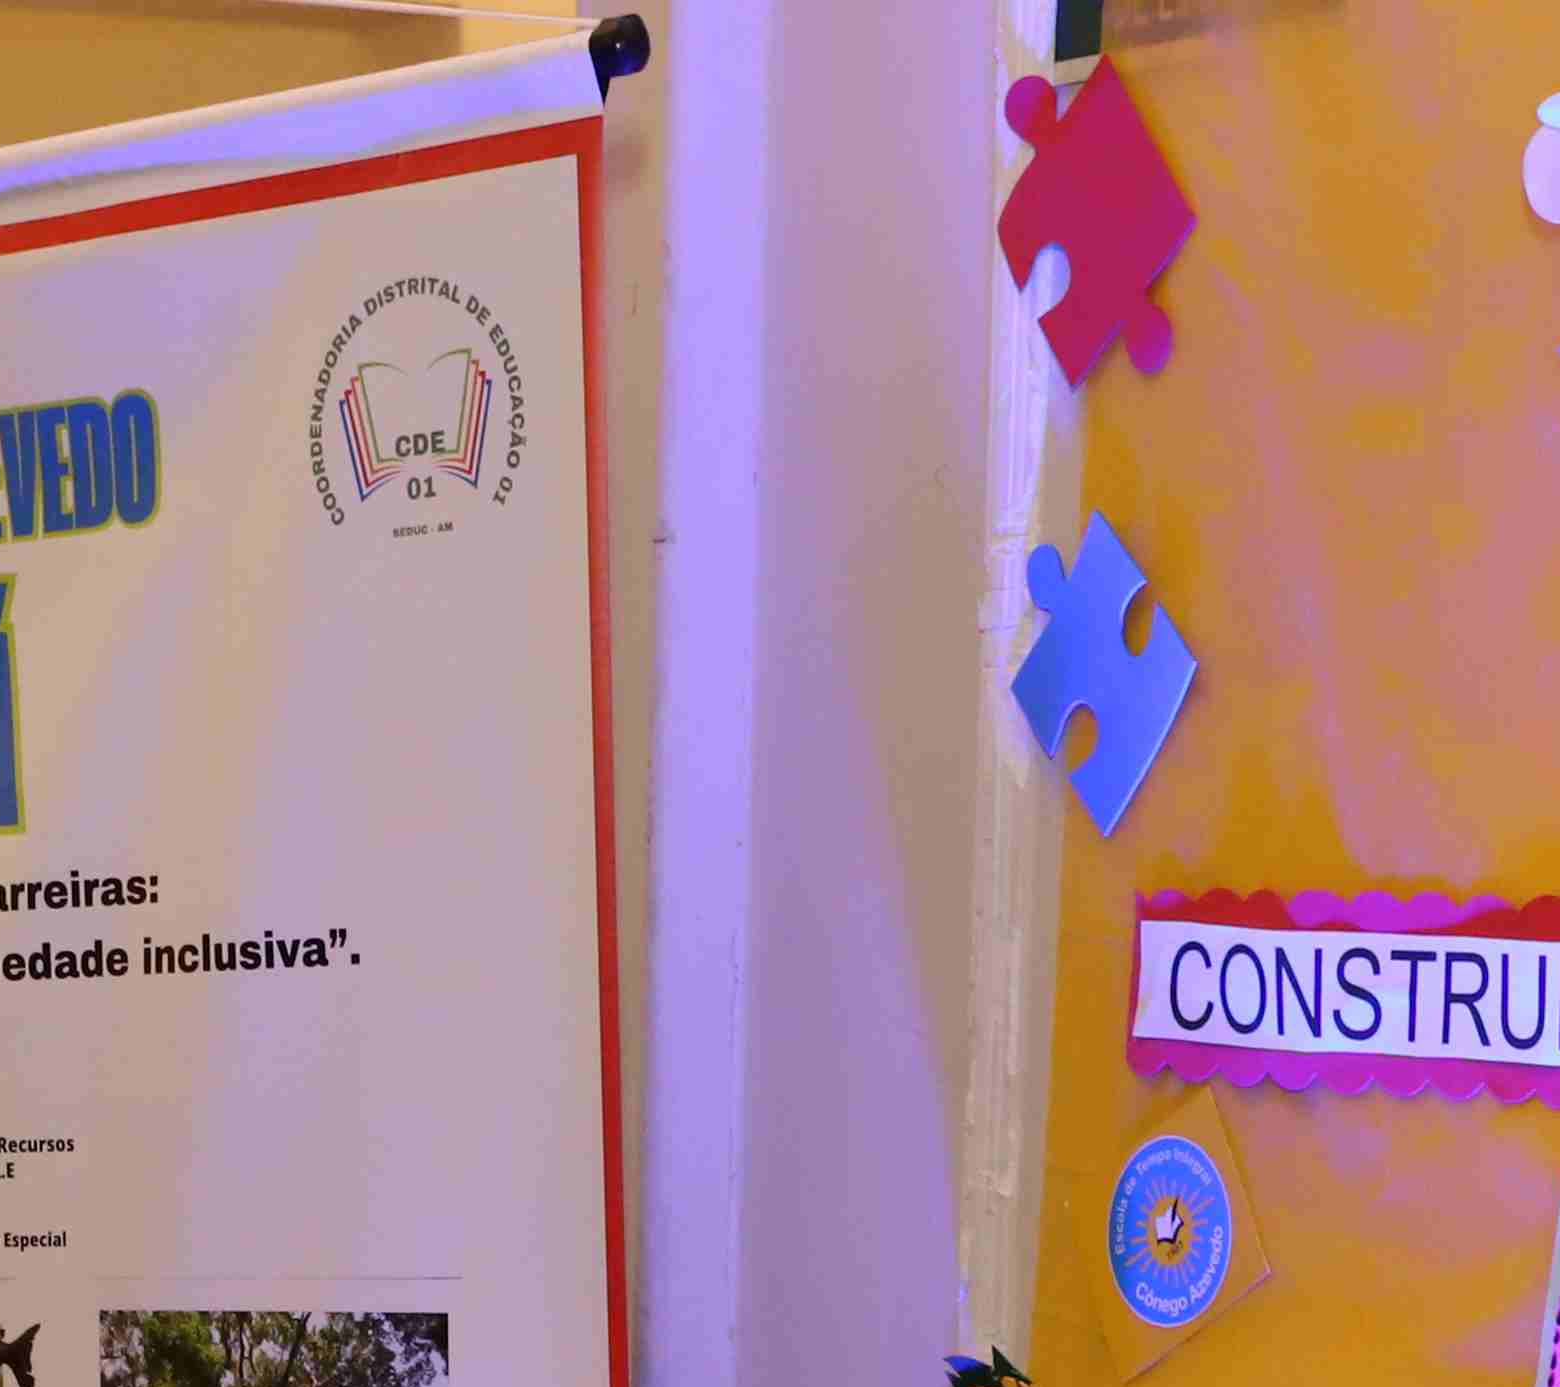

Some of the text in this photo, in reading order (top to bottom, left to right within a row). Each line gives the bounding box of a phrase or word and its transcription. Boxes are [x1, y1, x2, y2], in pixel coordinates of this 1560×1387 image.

[309, 276, 527, 526] COORDENADORIA DISTRITAL DE EDUCAÇÃO 01
[395, 431, 446, 457] CDE
[407, 476, 437, 500] 01
[3, 1231, 68, 1251] Especial
